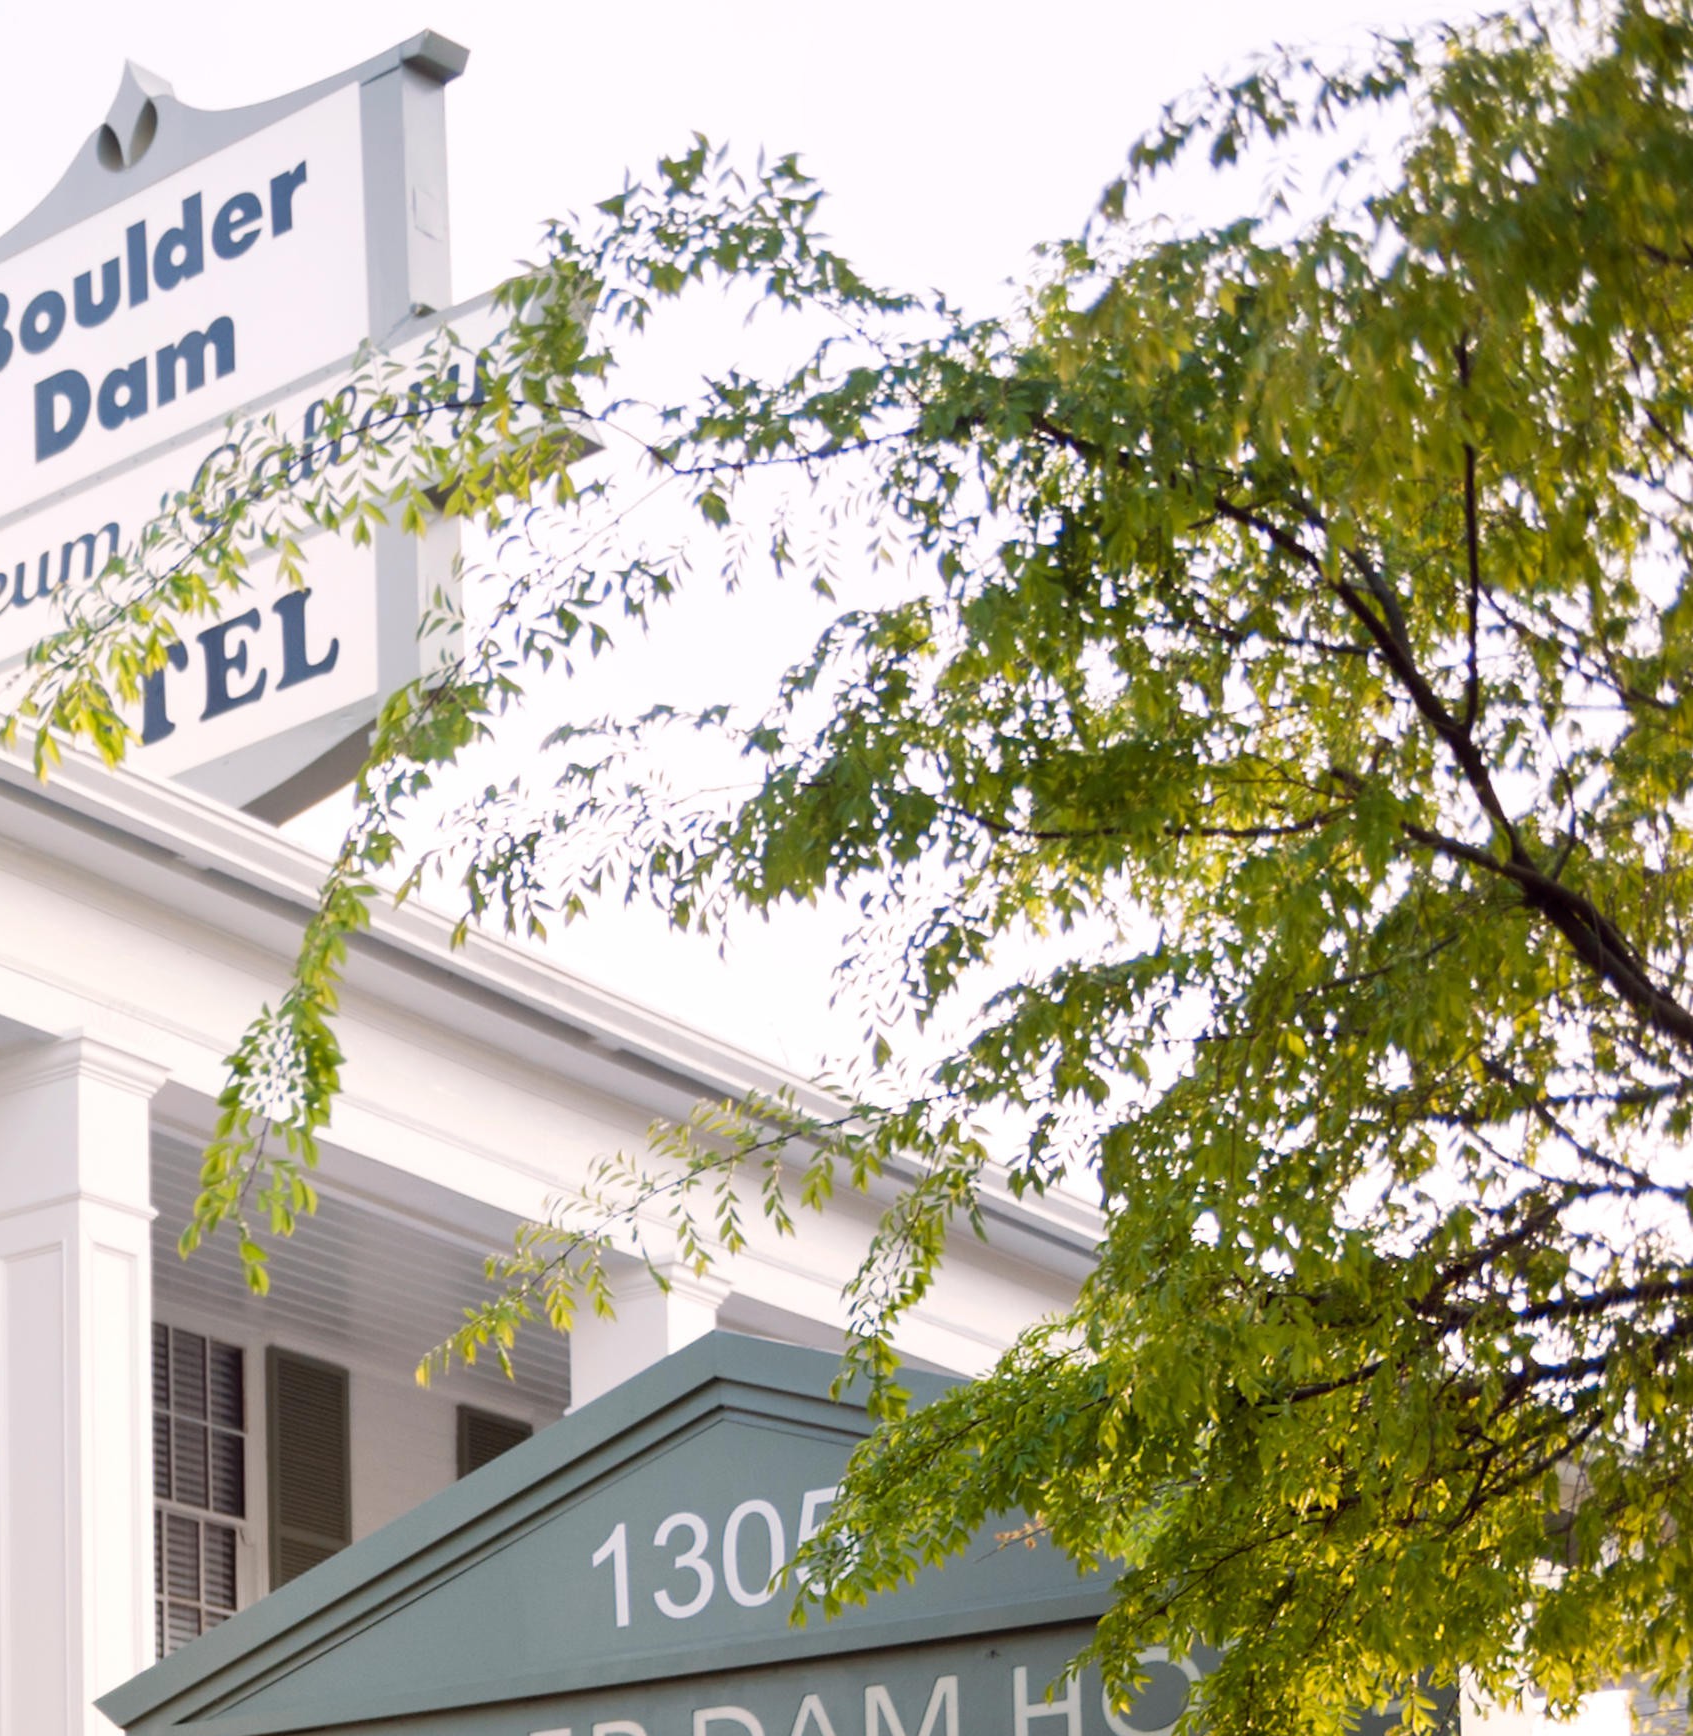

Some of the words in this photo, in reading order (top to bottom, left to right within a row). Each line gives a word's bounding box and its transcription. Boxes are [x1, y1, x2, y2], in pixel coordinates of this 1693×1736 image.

[34, 315, 237, 464] Dam
[123, 587, 340, 747] TEL
[592, 1486, 861, 1628] 1305
